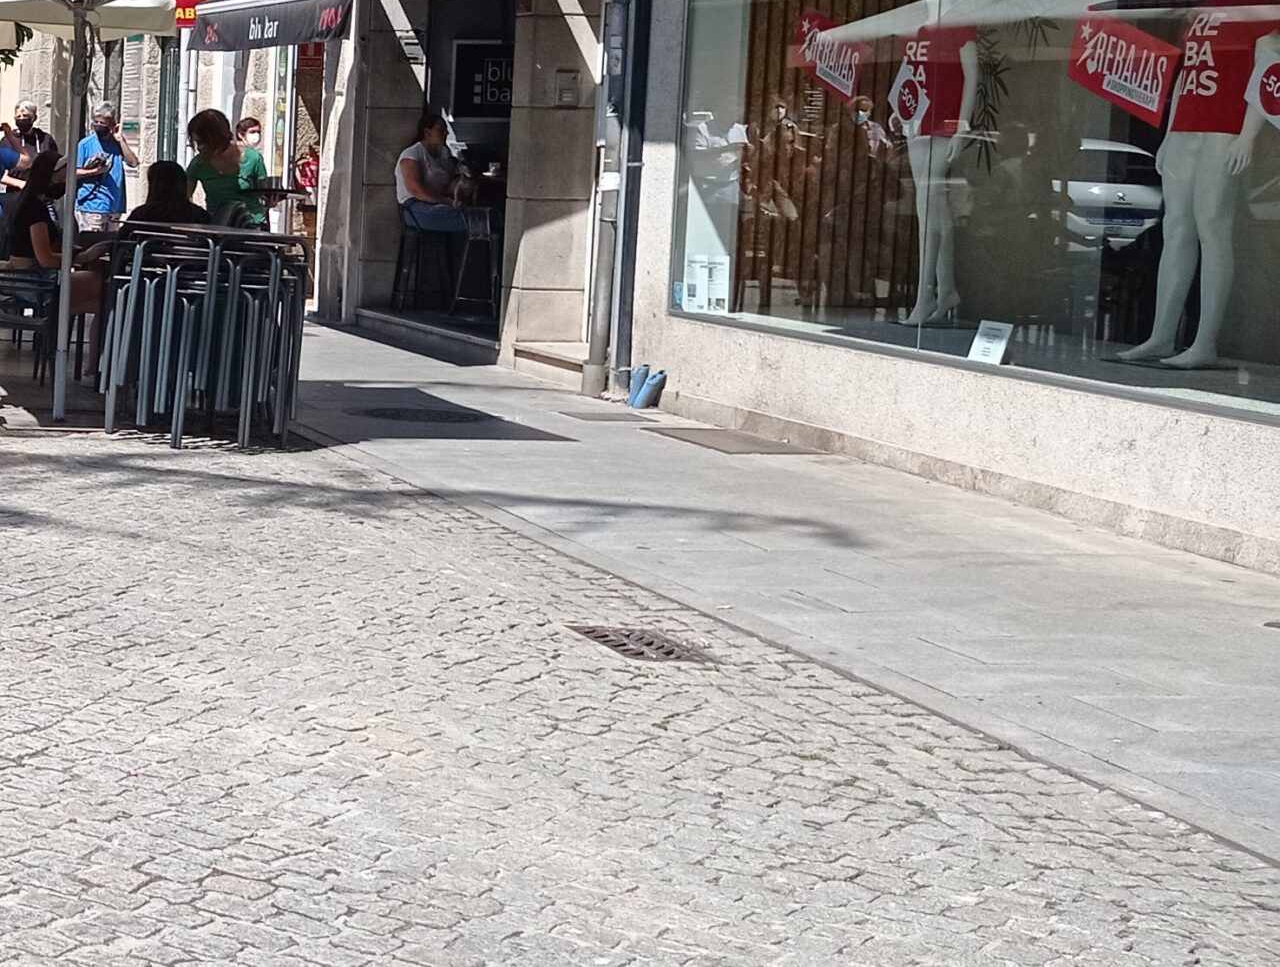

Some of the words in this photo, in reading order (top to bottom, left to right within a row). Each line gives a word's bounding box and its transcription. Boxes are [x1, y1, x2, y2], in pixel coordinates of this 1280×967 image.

[1188, 13, 1228, 37] RE
[808, 28, 859, 82] REBAJAS
[905, 41, 931, 62] RE
[1091, 32, 1168, 95] REBAJAS
[1184, 41, 1216, 67] BA
[487, 82, 513, 101] ba
